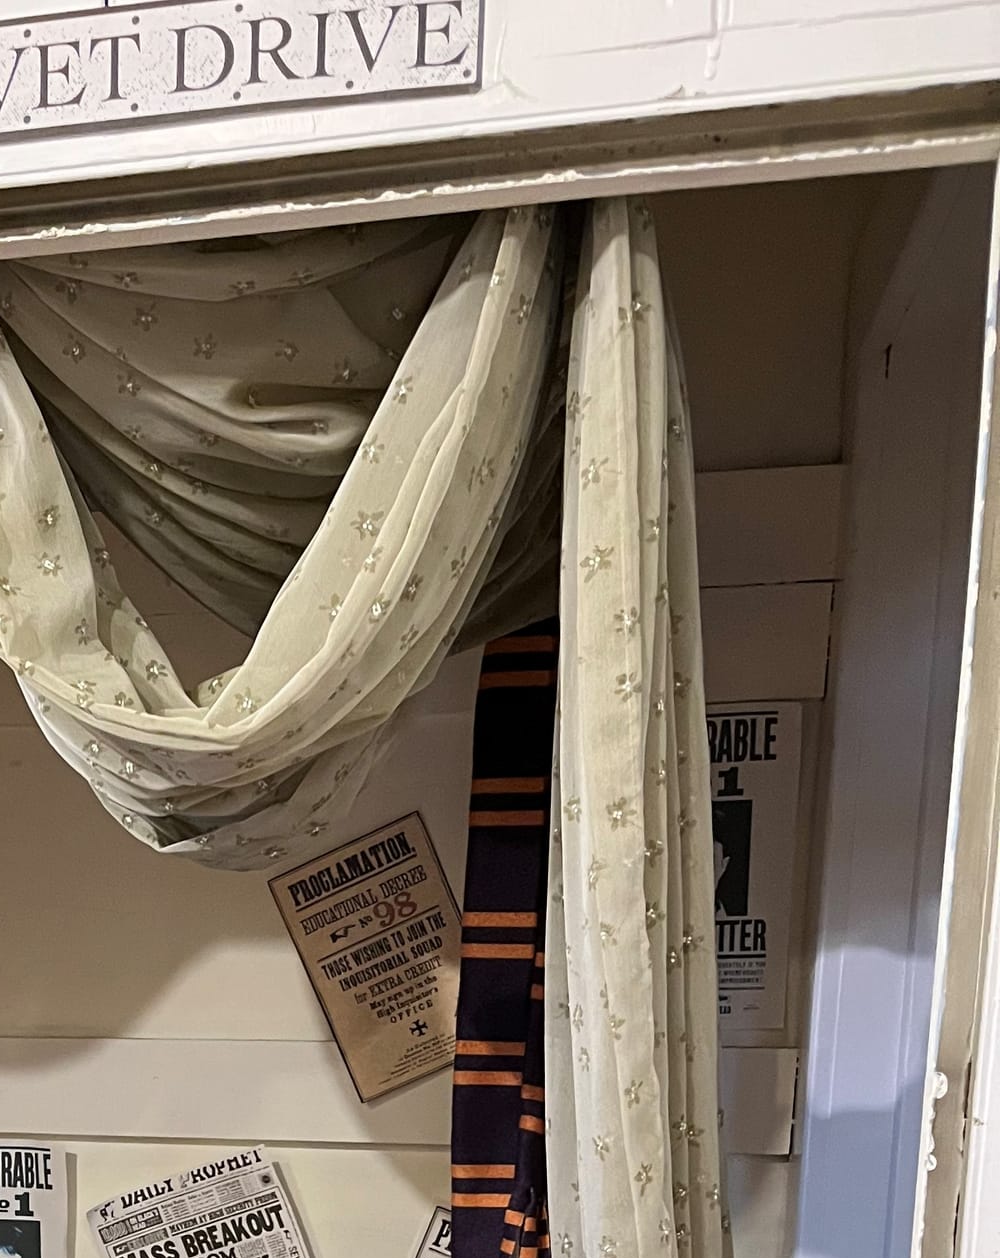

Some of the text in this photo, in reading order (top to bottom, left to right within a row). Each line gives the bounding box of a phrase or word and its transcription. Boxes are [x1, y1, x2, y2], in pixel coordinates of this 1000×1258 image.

[170, 1, 469, 95] DRIVE
[300, 865, 427, 936] EDUCATIONAL DECREE
[373, 892, 417, 928] 98
[321, 911, 447, 980] THOSE WISHING TO JOIN THE
[339, 936, 443, 992] INQUISITORIAL SQUAD
[368, 974, 404, 997] EXTRA
[404, 955, 442, 981] CREDIT
[391, 999, 433, 1024] OFFICE
[181, 1207, 286, 1258] BREAKOUT
